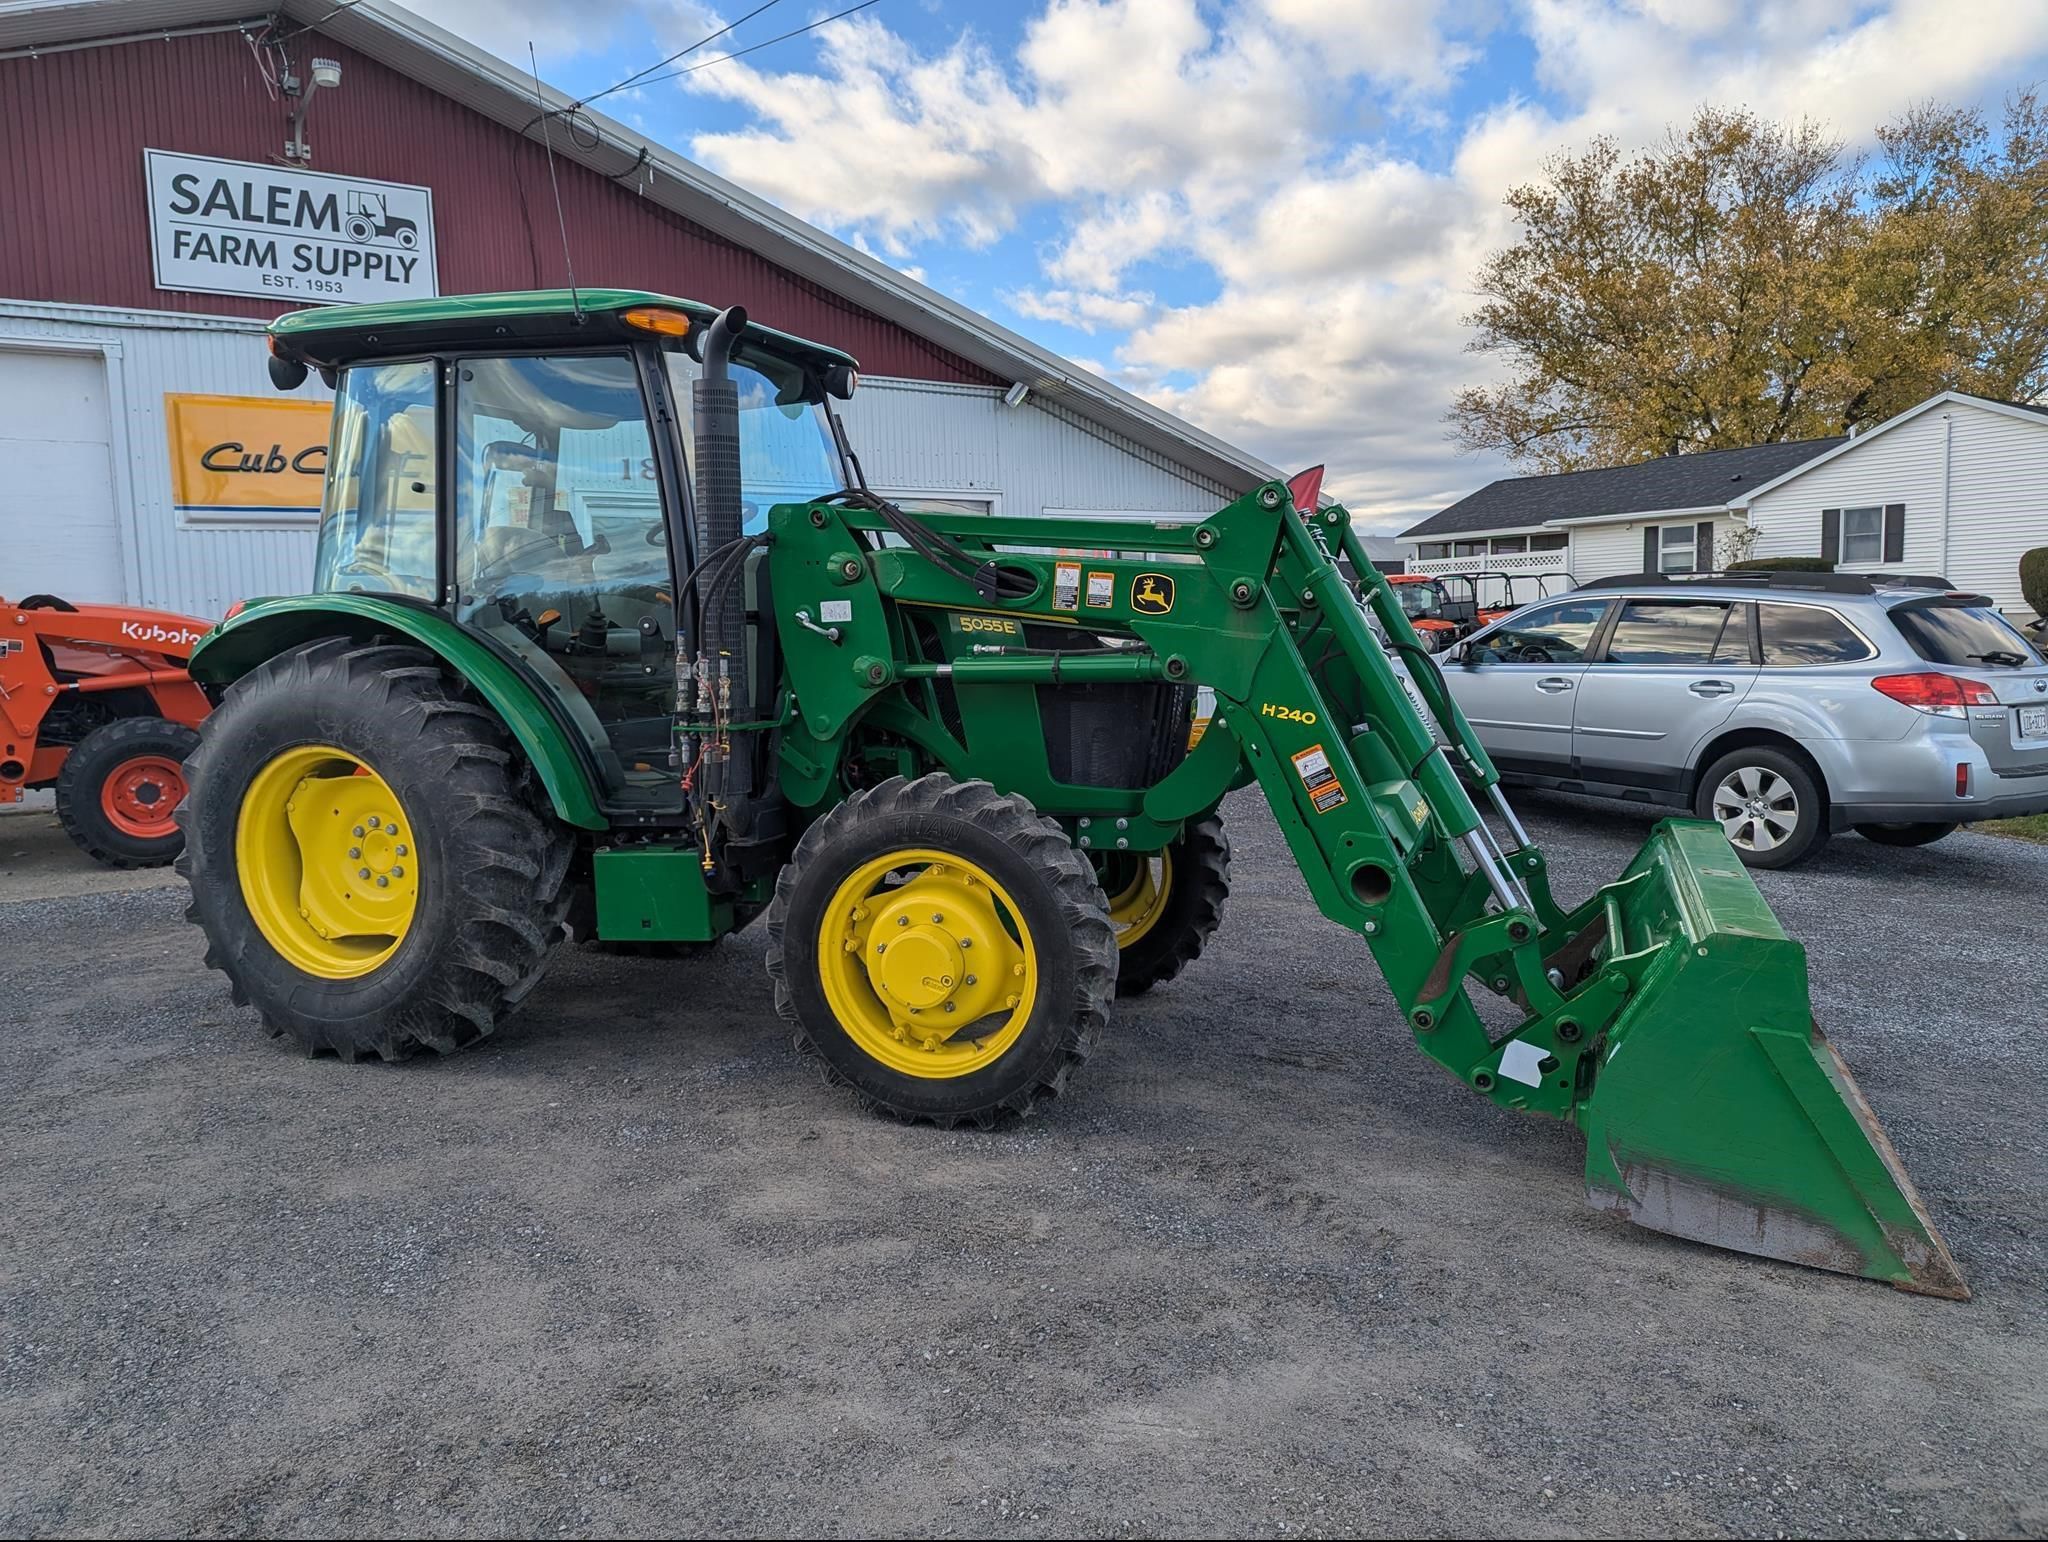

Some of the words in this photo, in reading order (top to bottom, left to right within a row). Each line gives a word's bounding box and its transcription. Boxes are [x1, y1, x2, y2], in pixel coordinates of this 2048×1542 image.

[169, 173, 341, 233] SALEM
[173, 229, 279, 270] FARM
[292, 243, 418, 284] SUPPLY
[262, 273, 299, 290] EST.
[306, 279, 344, 294] 1953
[200, 442, 288, 474] Cub
[960, 615, 1017, 634] 5055E
